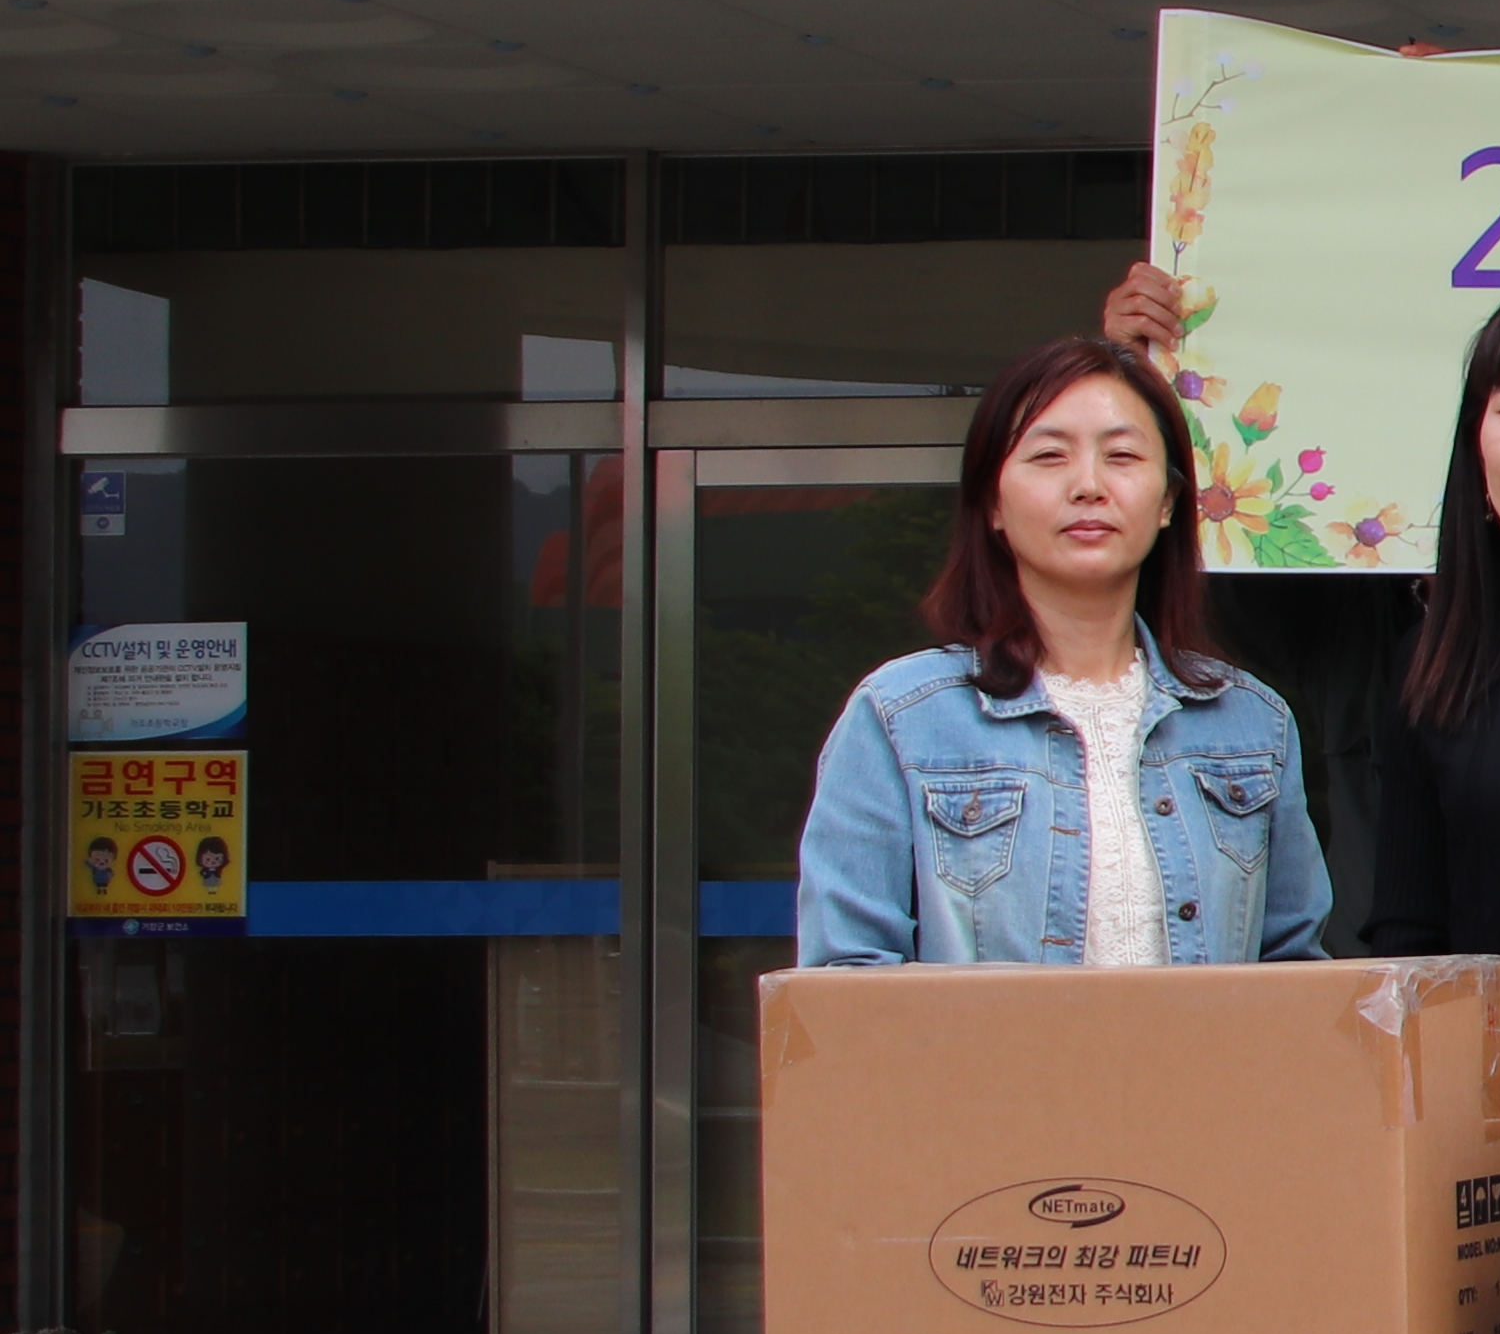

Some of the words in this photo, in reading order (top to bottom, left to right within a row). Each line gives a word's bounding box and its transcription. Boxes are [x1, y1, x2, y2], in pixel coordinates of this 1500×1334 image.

[82, 640, 151, 659] CCTV설치
[156, 640, 171, 659] 및
[176, 639, 237, 659] 운영안내
[81, 760, 237, 795] 금연구역
[81, 800, 234, 819] 가조초등학교
[115, 822, 128, 832] No
[135, 822, 182, 835] Smoking
[186, 822, 212, 831] Area
[1040, 1198, 1117, 1214] NETmate
[956, 1245, 1068, 1270] 네트워크의
[1073, 1245, 1120, 1270] 최강
[1125, 1244, 1201, 1269] 파트너!
[1008, 1283, 1087, 1306] 강원전자
[1094, 1283, 1173, 1306] 주식회사
